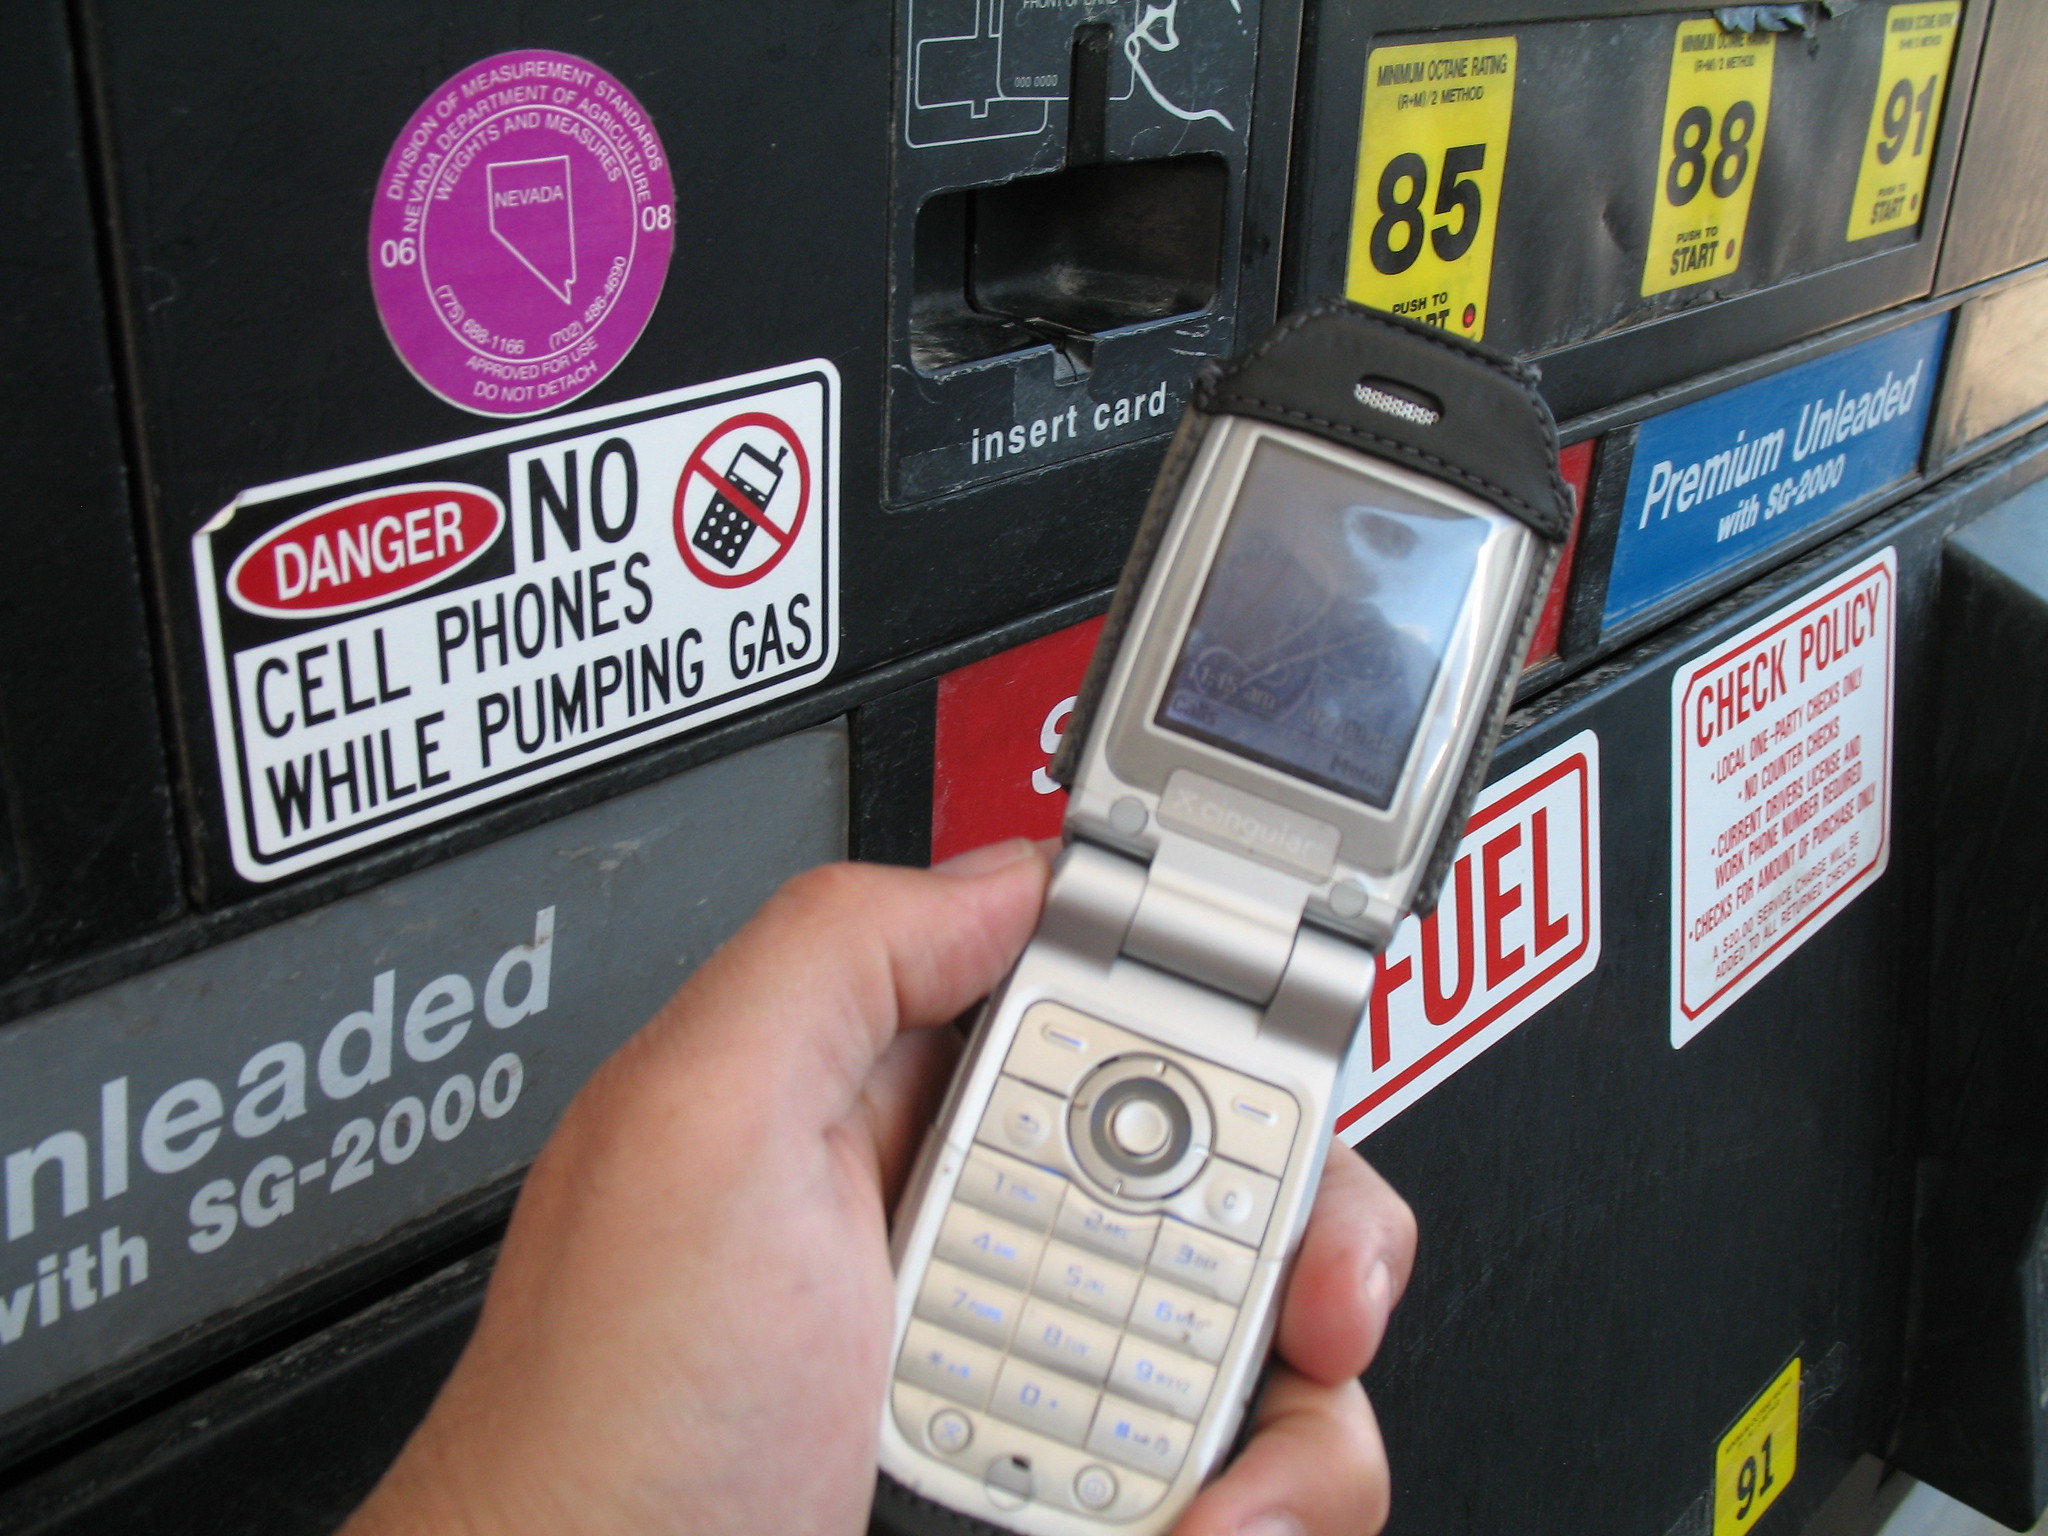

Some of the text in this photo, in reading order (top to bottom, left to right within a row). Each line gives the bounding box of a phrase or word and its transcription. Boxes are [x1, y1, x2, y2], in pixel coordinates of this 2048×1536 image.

[1377, 53, 1508, 87] MINIMUM OCTANE RATING
[1441, 86, 1484, 104] METHOD
[387, 61, 663, 200] DIVISION OF MEASUREMENT STANDARDS
[403, 85, 652, 233] NEVADA DEPARTMENT OF AGRICULTURE
[434, 112, 623, 202] WEIGHTS AND MEASURES
[1666, 100, 1756, 207] 88
[1876, 74, 1938, 165] 91
[494, 185, 564, 208] NEVADA
[641, 204, 671, 231] 08
[1370, 143, 1487, 276] 85
[1676, 225, 1718, 244] PUSH TO
[1870, 196, 1905, 225] START
[380, 238, 417, 268] 06
[1669, 240, 1719, 277] START
[435, 284, 465, 325] (775)
[549, 321, 583, 350] (702)
[1392, 291, 1449, 315] PUSH TO
[466, 336, 599, 380] APPROVED FOR USE
[473, 361, 598, 401] DO NOT DETACH
[970, 380, 1168, 465] insert card
[1638, 358, 1925, 530] Premium Unleaded
[526, 436, 639, 562] NO
[1716, 453, 1846, 544] with SG-2000
[273, 501, 464, 601] DANGER
[255, 551, 653, 739] CELL PHONES
[1696, 582, 1880, 748] CHECK POLICY
[265, 592, 812, 838] WHILE PUMPING GAS
[1717, 745, 1746, 784] LOCAL
[1807, 682, 1840, 722] CHECKS
[1761, 742, 1803, 790] COUNTER
[1807, 716, 1840, 757] CHECKS
[1715, 848, 1745, 889] WORK
[1749, 822, 1779, 865] PHONE
[1782, 792, 1819, 839] NUMBER
[1718, 805, 1762, 858] CURRENT
[1766, 776, 1804, 822] DRIVERS
[1807, 749, 1840, 792] LICENSE
[1695, 893, 1732, 941] CHECKS
[1736, 877, 1754, 910] FOR
[1758, 843, 1796, 893] AMOUNT
[1368, 806, 1570, 1073] FUEL
[3, 904, 557, 1242] nleaded
[187, 1052, 524, 1254] SG-2000
[972, 1233, 991, 1252] 4
[1066, 1265, 1081, 1286] 5
[951, 1289, 968, 1308] 7
[1155, 1300, 1172, 1323] 6
[1736, 1432, 1774, 1521] 91
